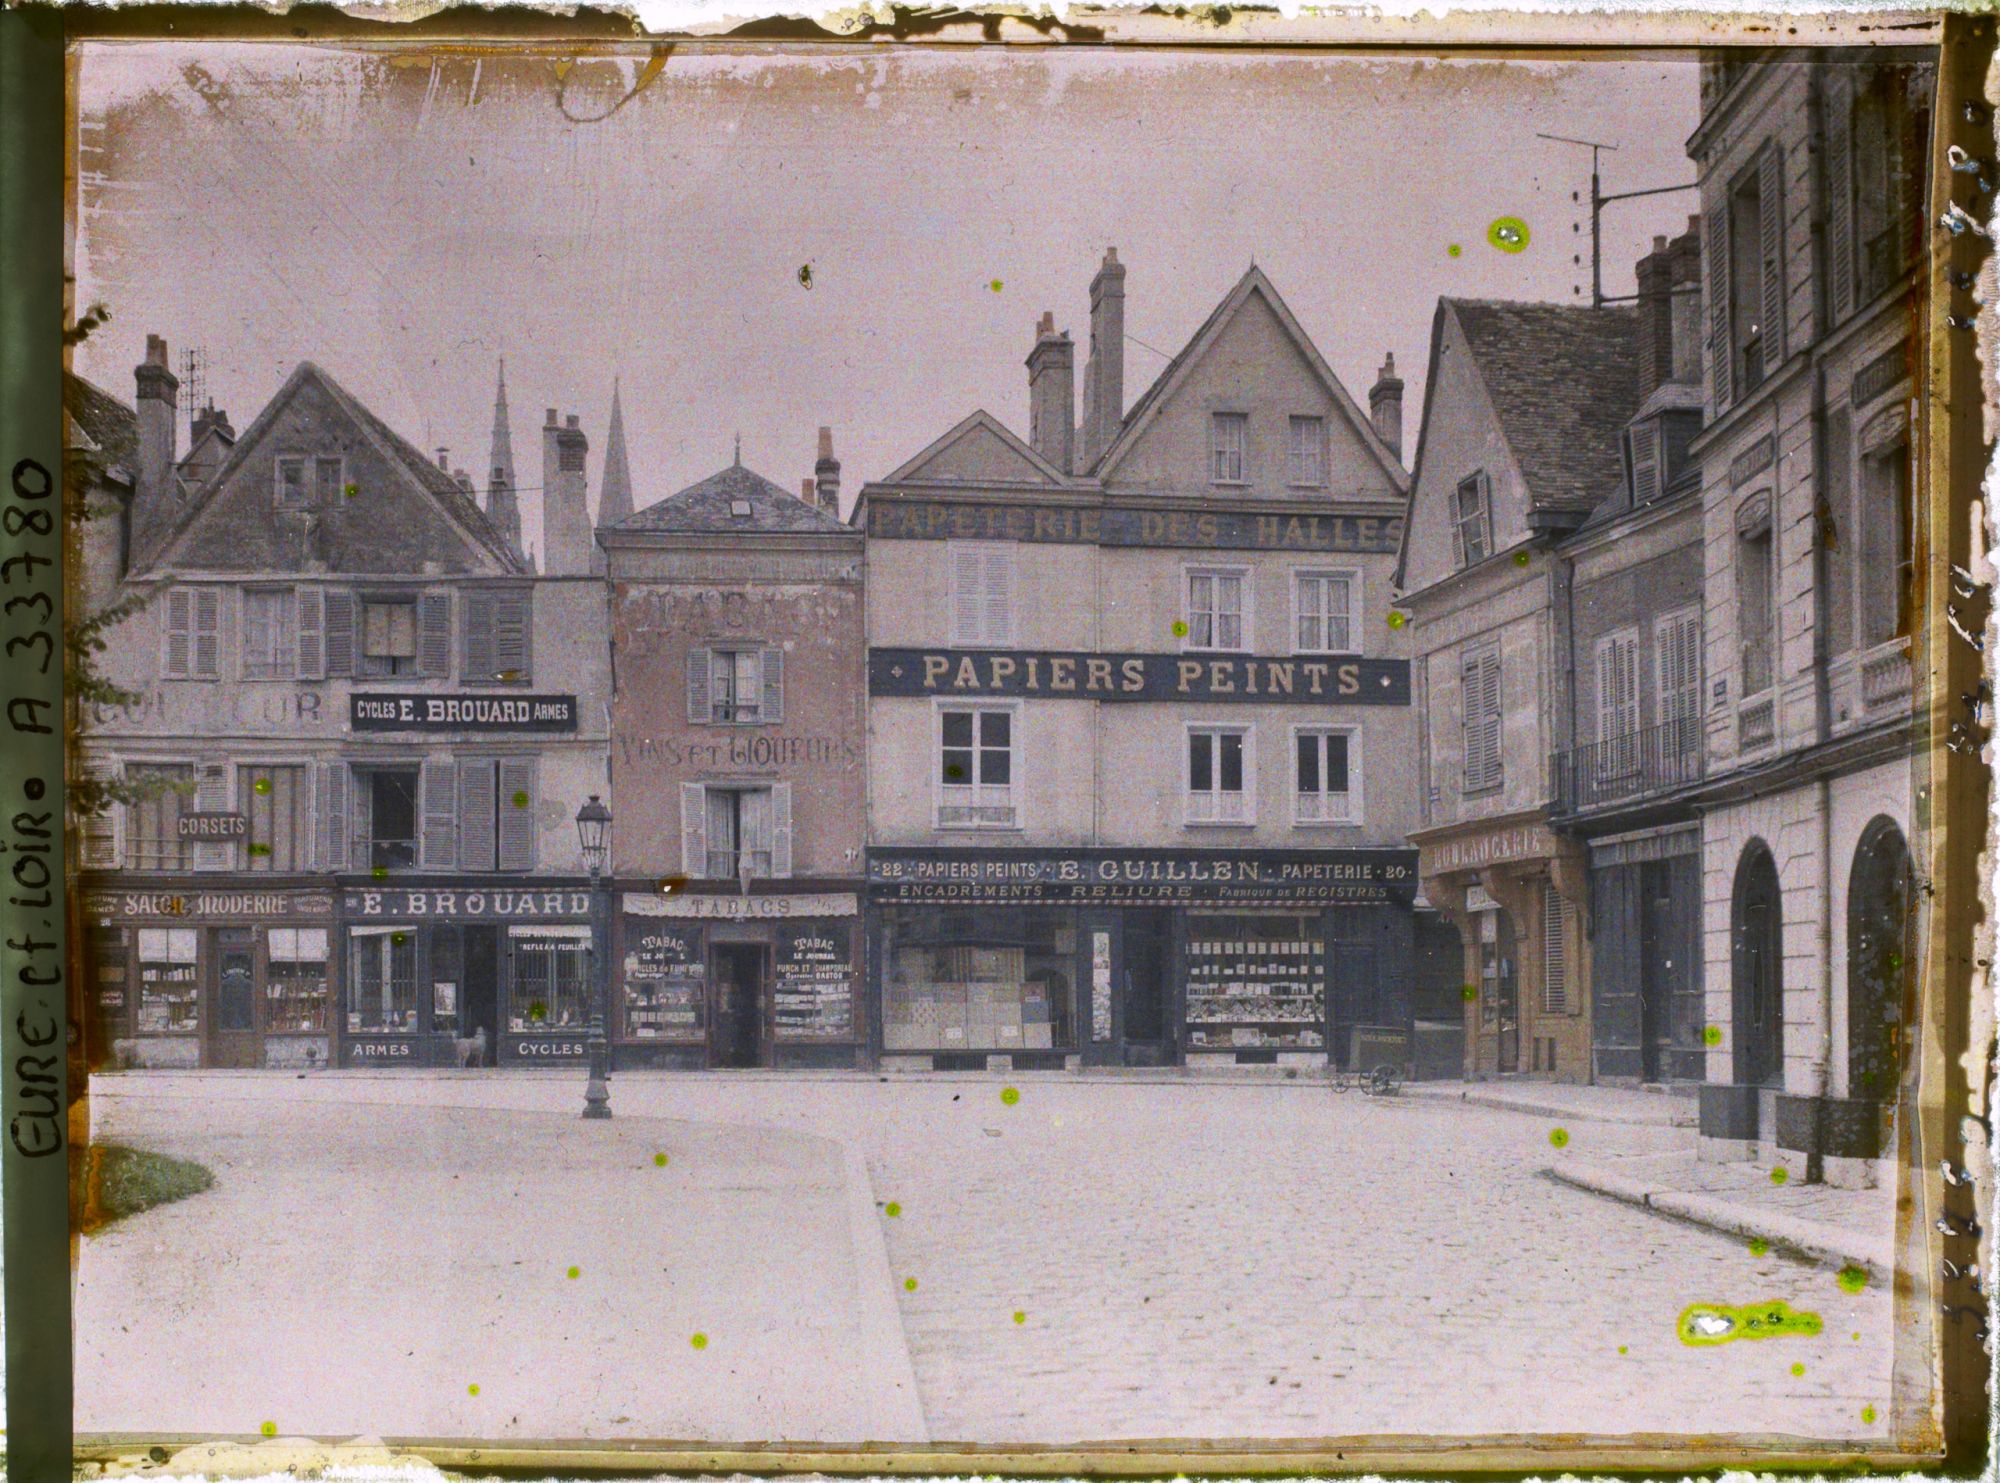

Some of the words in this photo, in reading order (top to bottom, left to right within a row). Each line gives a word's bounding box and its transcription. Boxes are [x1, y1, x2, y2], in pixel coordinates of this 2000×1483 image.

[875, 504, 1100, 538] PAPETERIE
[1141, 513, 1217, 544] DES
[1256, 516, 1402, 548] HALLES
[3, 458, 57, 674] 33780
[923, 655, 1144, 692] PAPIERS
[1178, 661, 1361, 695] PEINTS
[7, 697, 55, 735] A
[357, 701, 396, 719] CYCLES
[400, 699, 421, 721] E.
[427, 699, 529, 722] BROUARD
[534, 703, 568, 720] ARMES
[179, 817, 245, 835] CORSETS
[882, 863, 902, 876] 22
[918, 863, 979, 877] PAPIERS
[987, 863, 1037, 877] PEINTS
[1059, 860, 1086, 880] E.
[1098, 860, 1259, 881] GUILLEN
[1282, 864, 1372, 879] PAPETERIE
[1385, 865, 1405, 879] 20
[900, 885, 1043, 897] ENCADREMENTS
[1070, 886, 1192, 898] RELIURE
[1219, 887, 1272, 897] FABRIQUE
[1296, 887, 1388, 898] REGISTRES
[196, 894, 288, 915] MODERNE
[363, 893, 398, 914] E.
[407, 893, 590, 915] BROUARD
[692, 899, 791, 915] TABACS
[642, 935, 684, 951] TABAC
[793, 937, 834, 951] TABAC
[353, 1044, 409, 1055] ARMES
[518, 1042, 583, 1055] CYCLES
